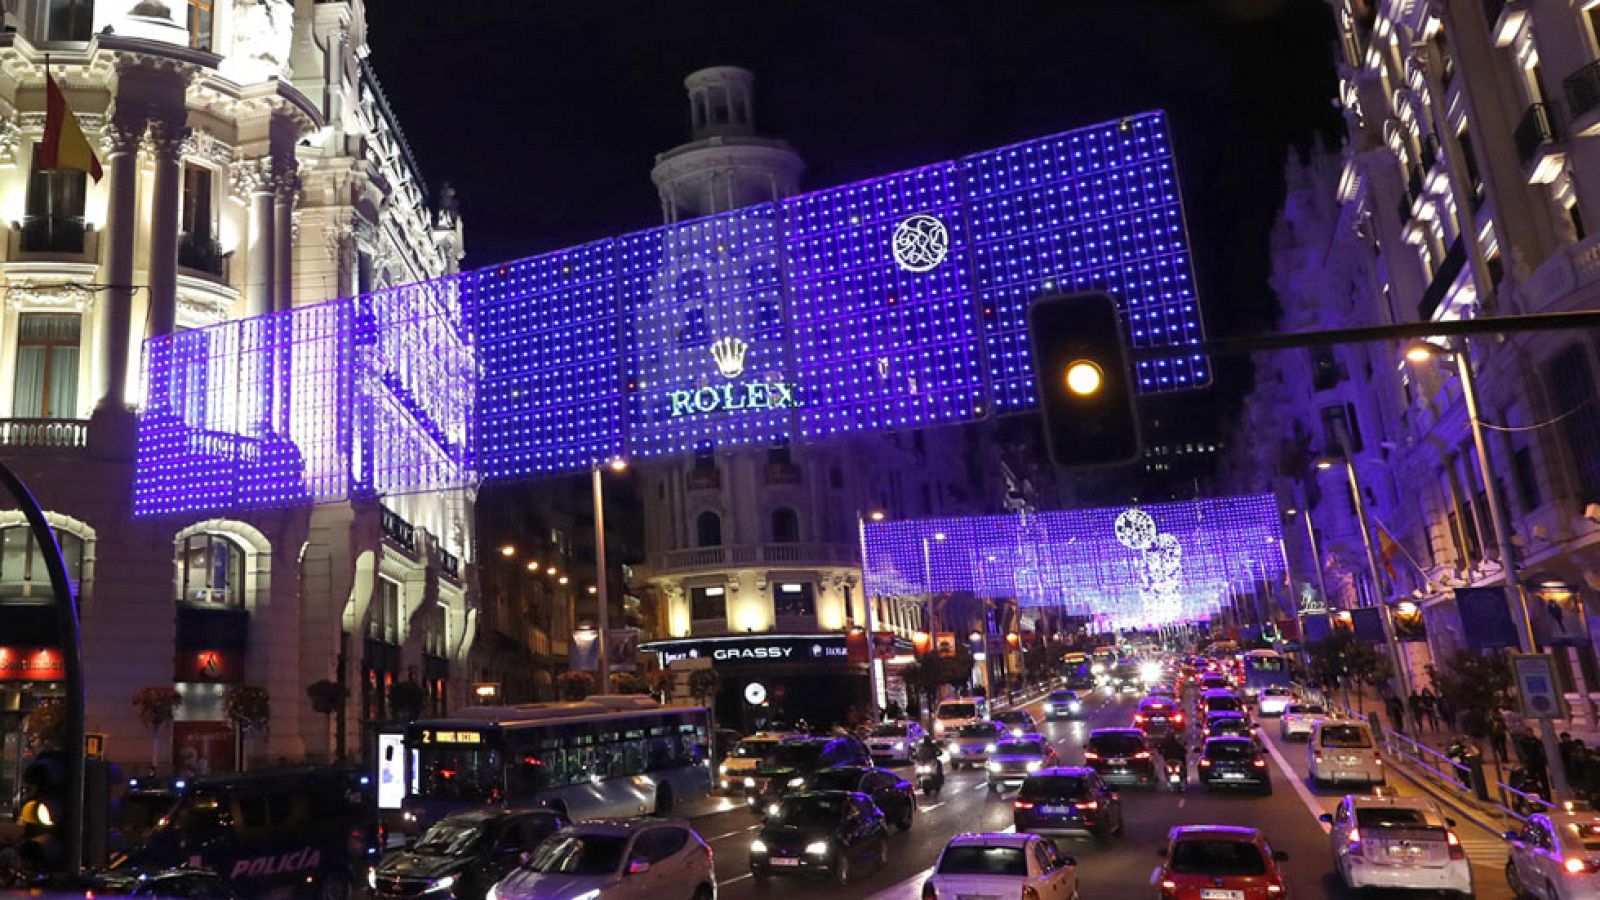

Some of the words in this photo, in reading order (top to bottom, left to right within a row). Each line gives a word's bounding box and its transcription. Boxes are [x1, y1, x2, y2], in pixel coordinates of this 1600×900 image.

[669, 383, 797, 416] ROLEX
[714, 647, 792, 660] GRASSY
[422, 730, 430, 743] 2
[230, 847, 320, 878] POLICÍA
